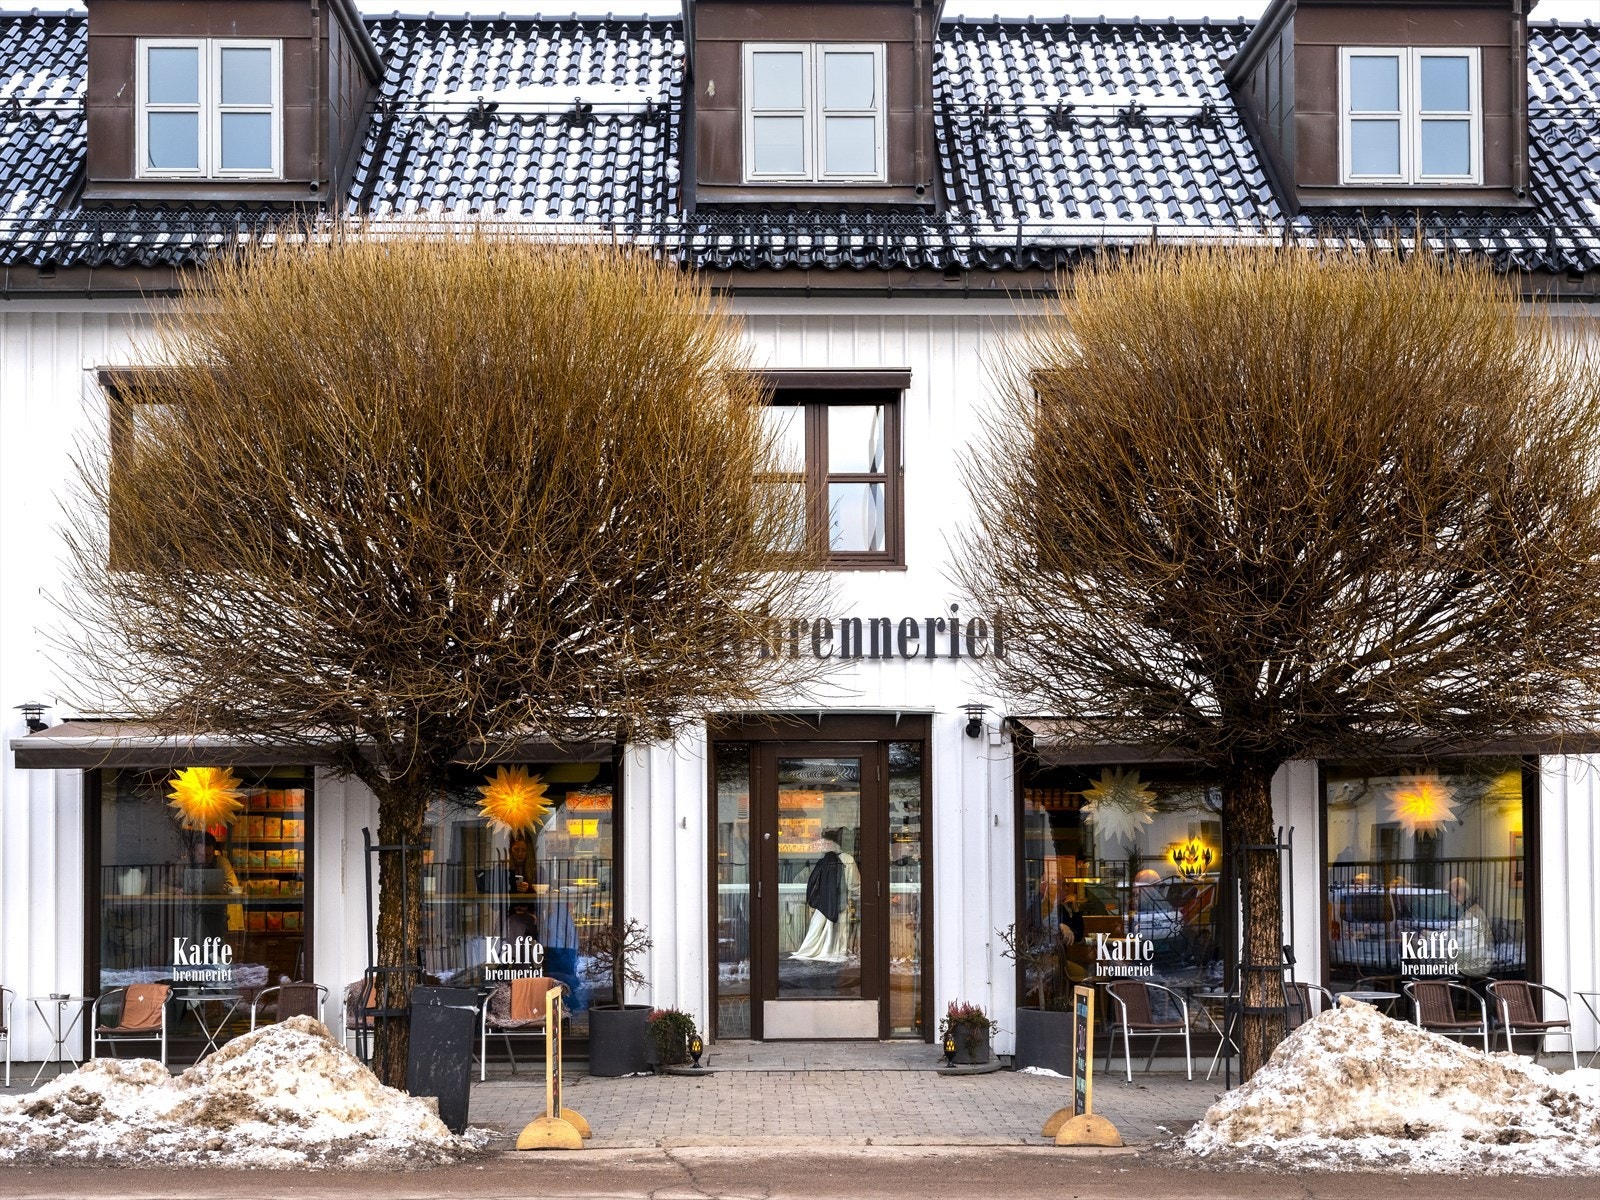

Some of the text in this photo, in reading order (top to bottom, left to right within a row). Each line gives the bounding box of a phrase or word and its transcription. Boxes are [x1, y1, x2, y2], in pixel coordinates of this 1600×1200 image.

[173, 936, 233, 966] Kaffe
[485, 935, 544, 964] Kaffe
[1096, 932, 1154, 961] Kaffe
[1401, 930, 1459, 959] Kaffe
[173, 967, 232, 982] brenneriet
[485, 966, 543, 981] brenneriet
[1096, 962, 1154, 977] brenneriet
[1401, 961, 1459, 975] brenneriet
